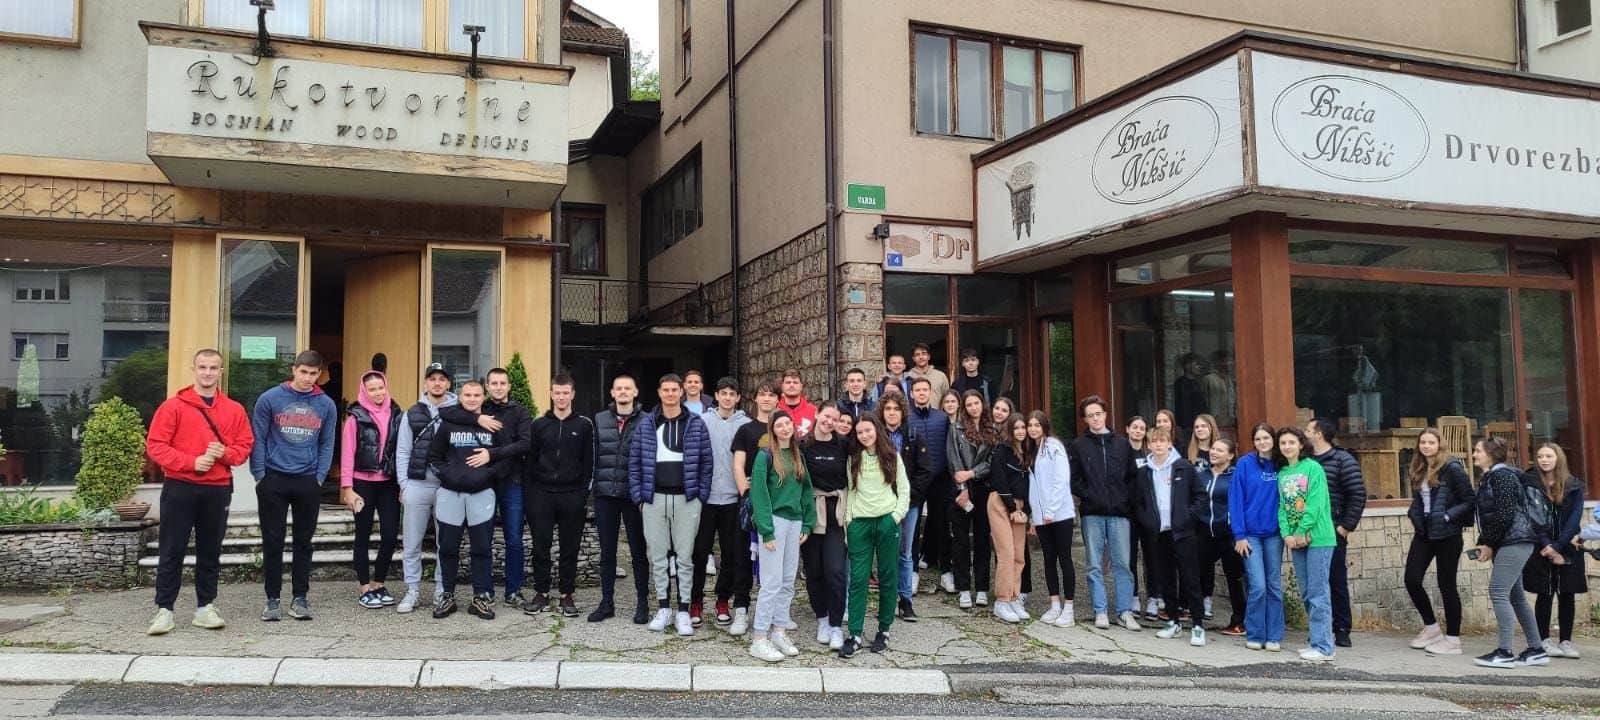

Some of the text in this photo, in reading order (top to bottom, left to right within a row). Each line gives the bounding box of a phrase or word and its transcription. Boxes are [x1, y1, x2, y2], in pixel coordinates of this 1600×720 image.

[186, 59, 532, 122] Rukotvorine
[1302, 84, 1377, 123] Braća
[190, 111, 530, 152] BOSNIAN WOOD DESIGNS
[1110, 119, 1170, 159] Braća
[1302, 123, 1395, 168] Nikšić
[1111, 148, 1187, 197] Nikšić
